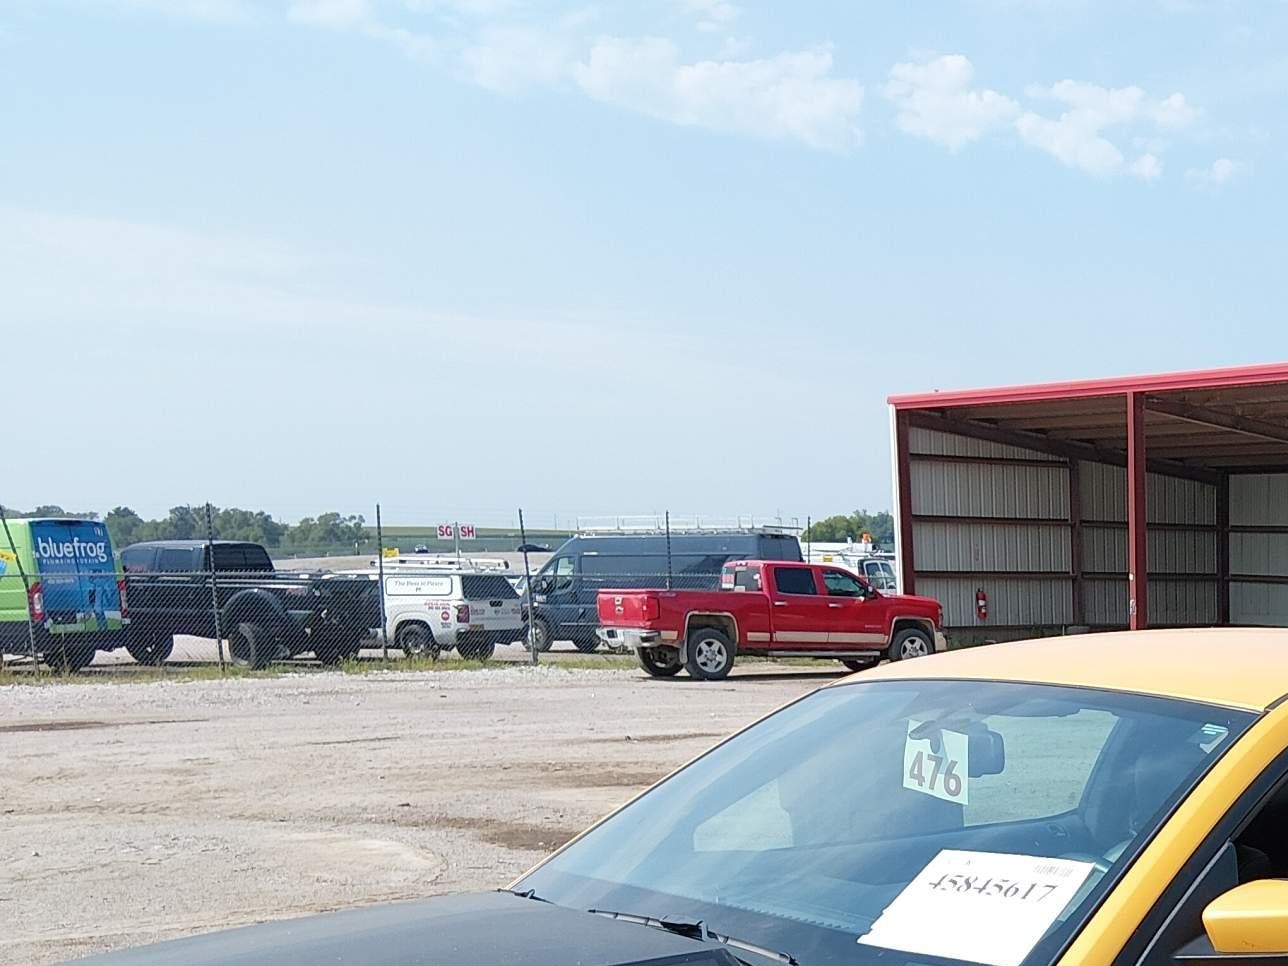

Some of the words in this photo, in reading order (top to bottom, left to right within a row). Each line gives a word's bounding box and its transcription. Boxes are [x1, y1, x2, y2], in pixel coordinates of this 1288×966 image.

[438, 525, 452, 537] SG
[460, 526, 475, 538] SH
[37, 536, 108, 563] bluefrog
[908, 750, 963, 798] 476
[928, 873, 1060, 902] 45845617
